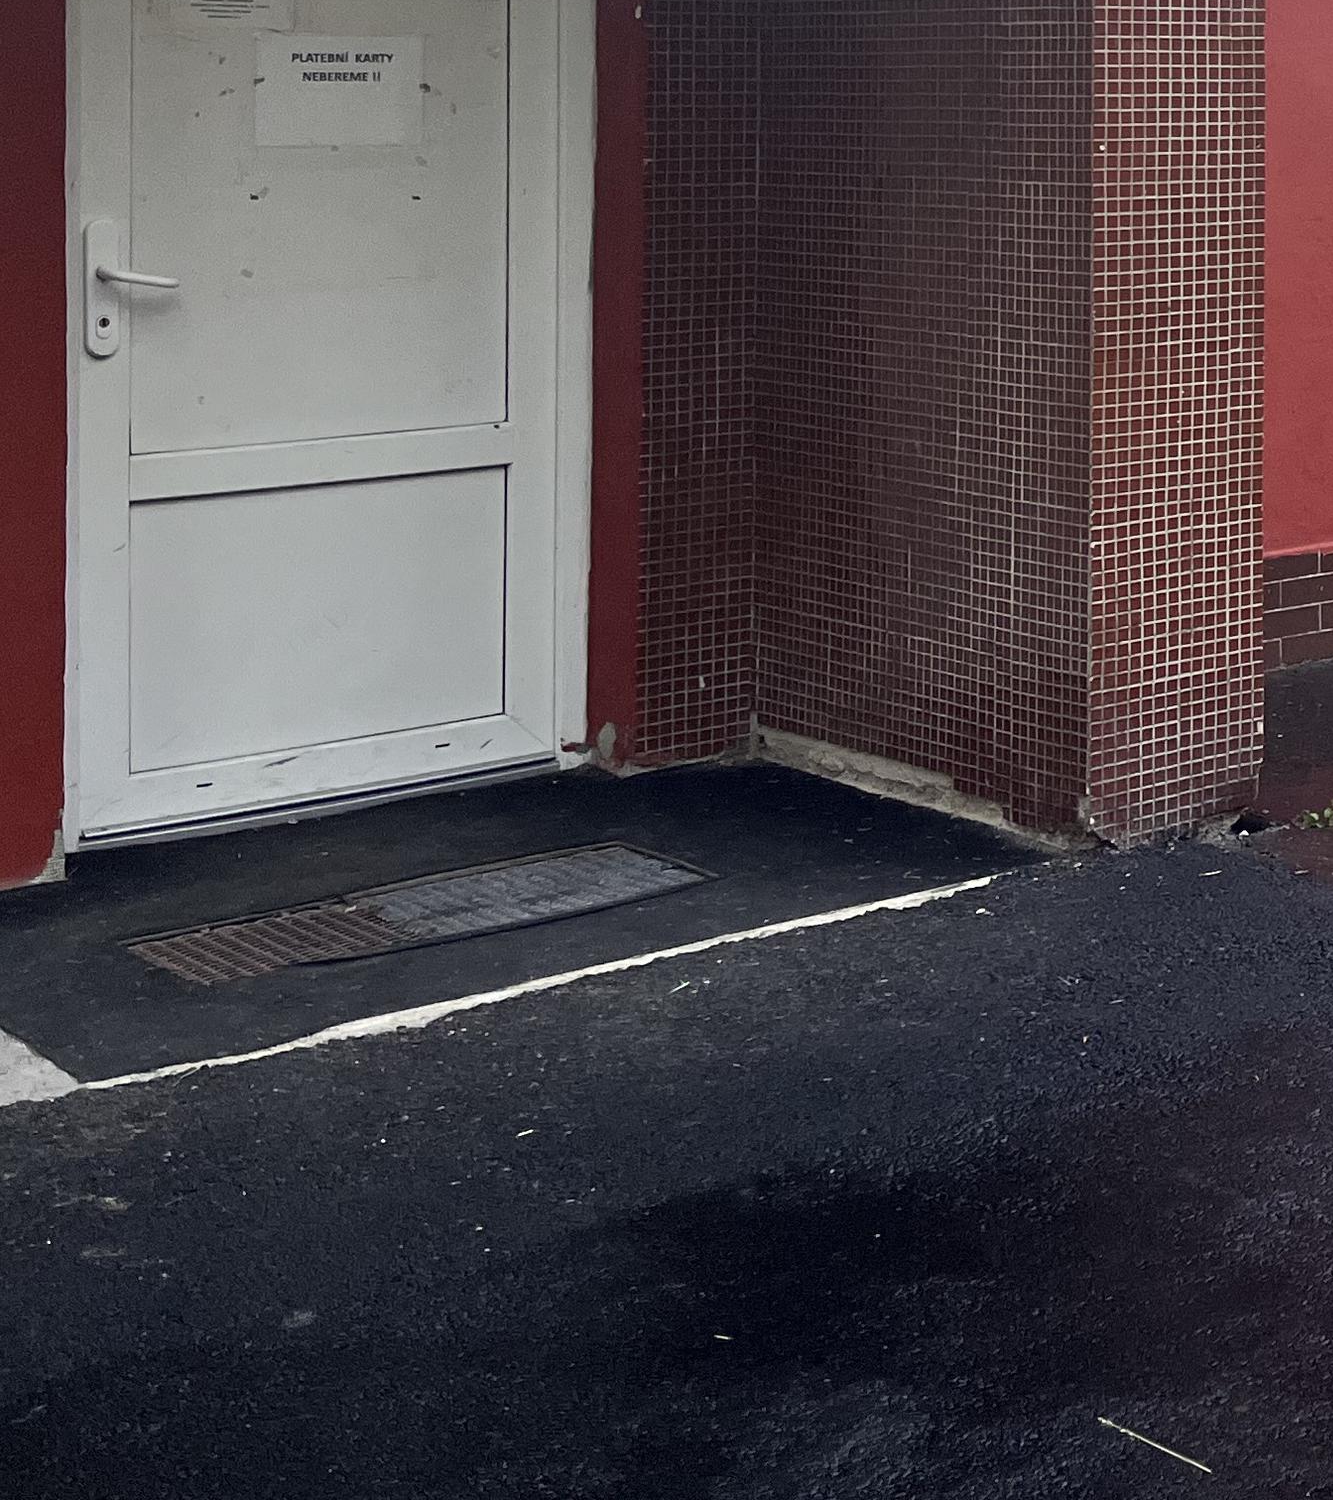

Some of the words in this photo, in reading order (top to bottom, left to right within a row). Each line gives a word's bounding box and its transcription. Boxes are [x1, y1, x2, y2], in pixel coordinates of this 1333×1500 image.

[291, 52, 349, 63] PLATEBNÍ
[355, 53, 393, 63] KARTY
[302, 72, 368, 82] NEBEREME
